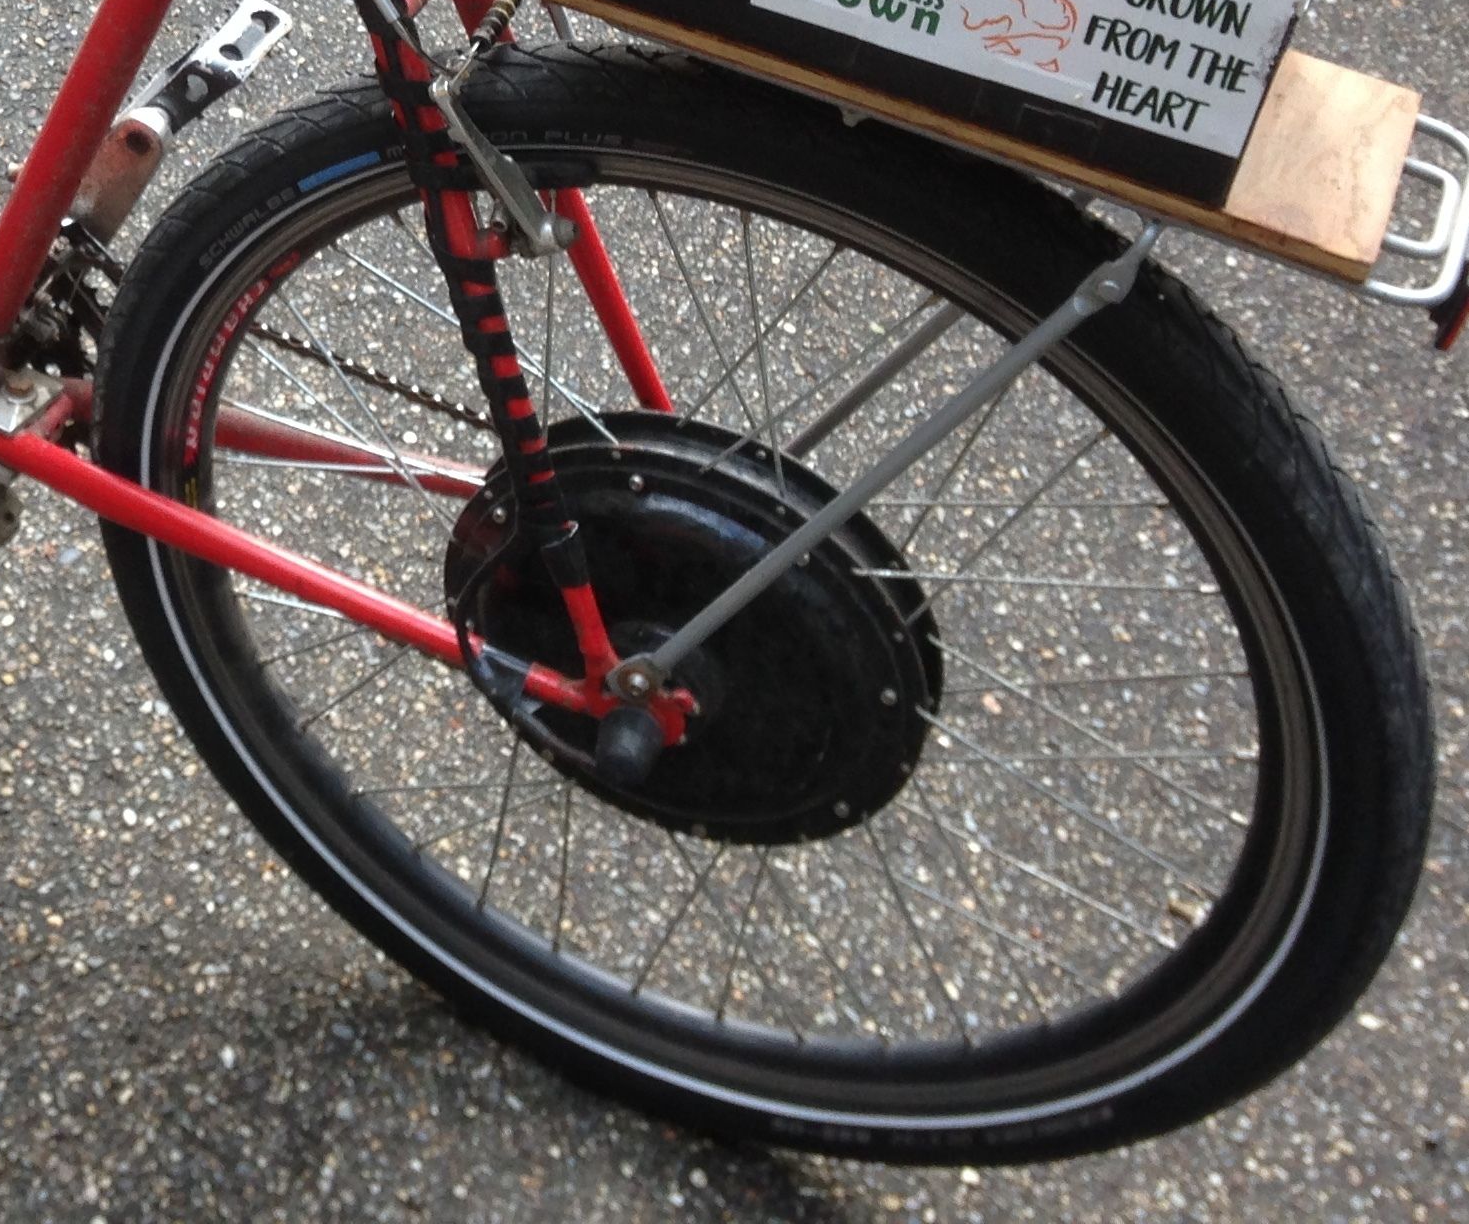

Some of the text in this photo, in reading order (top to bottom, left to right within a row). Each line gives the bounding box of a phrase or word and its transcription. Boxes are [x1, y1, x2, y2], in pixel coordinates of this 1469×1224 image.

[1083, 14, 1255, 94] FROM THE
[1092, 71, 1211, 133] HEART
[544, 130, 623, 147] PLUS
[198, 186, 296, 269] SCHWALBE
